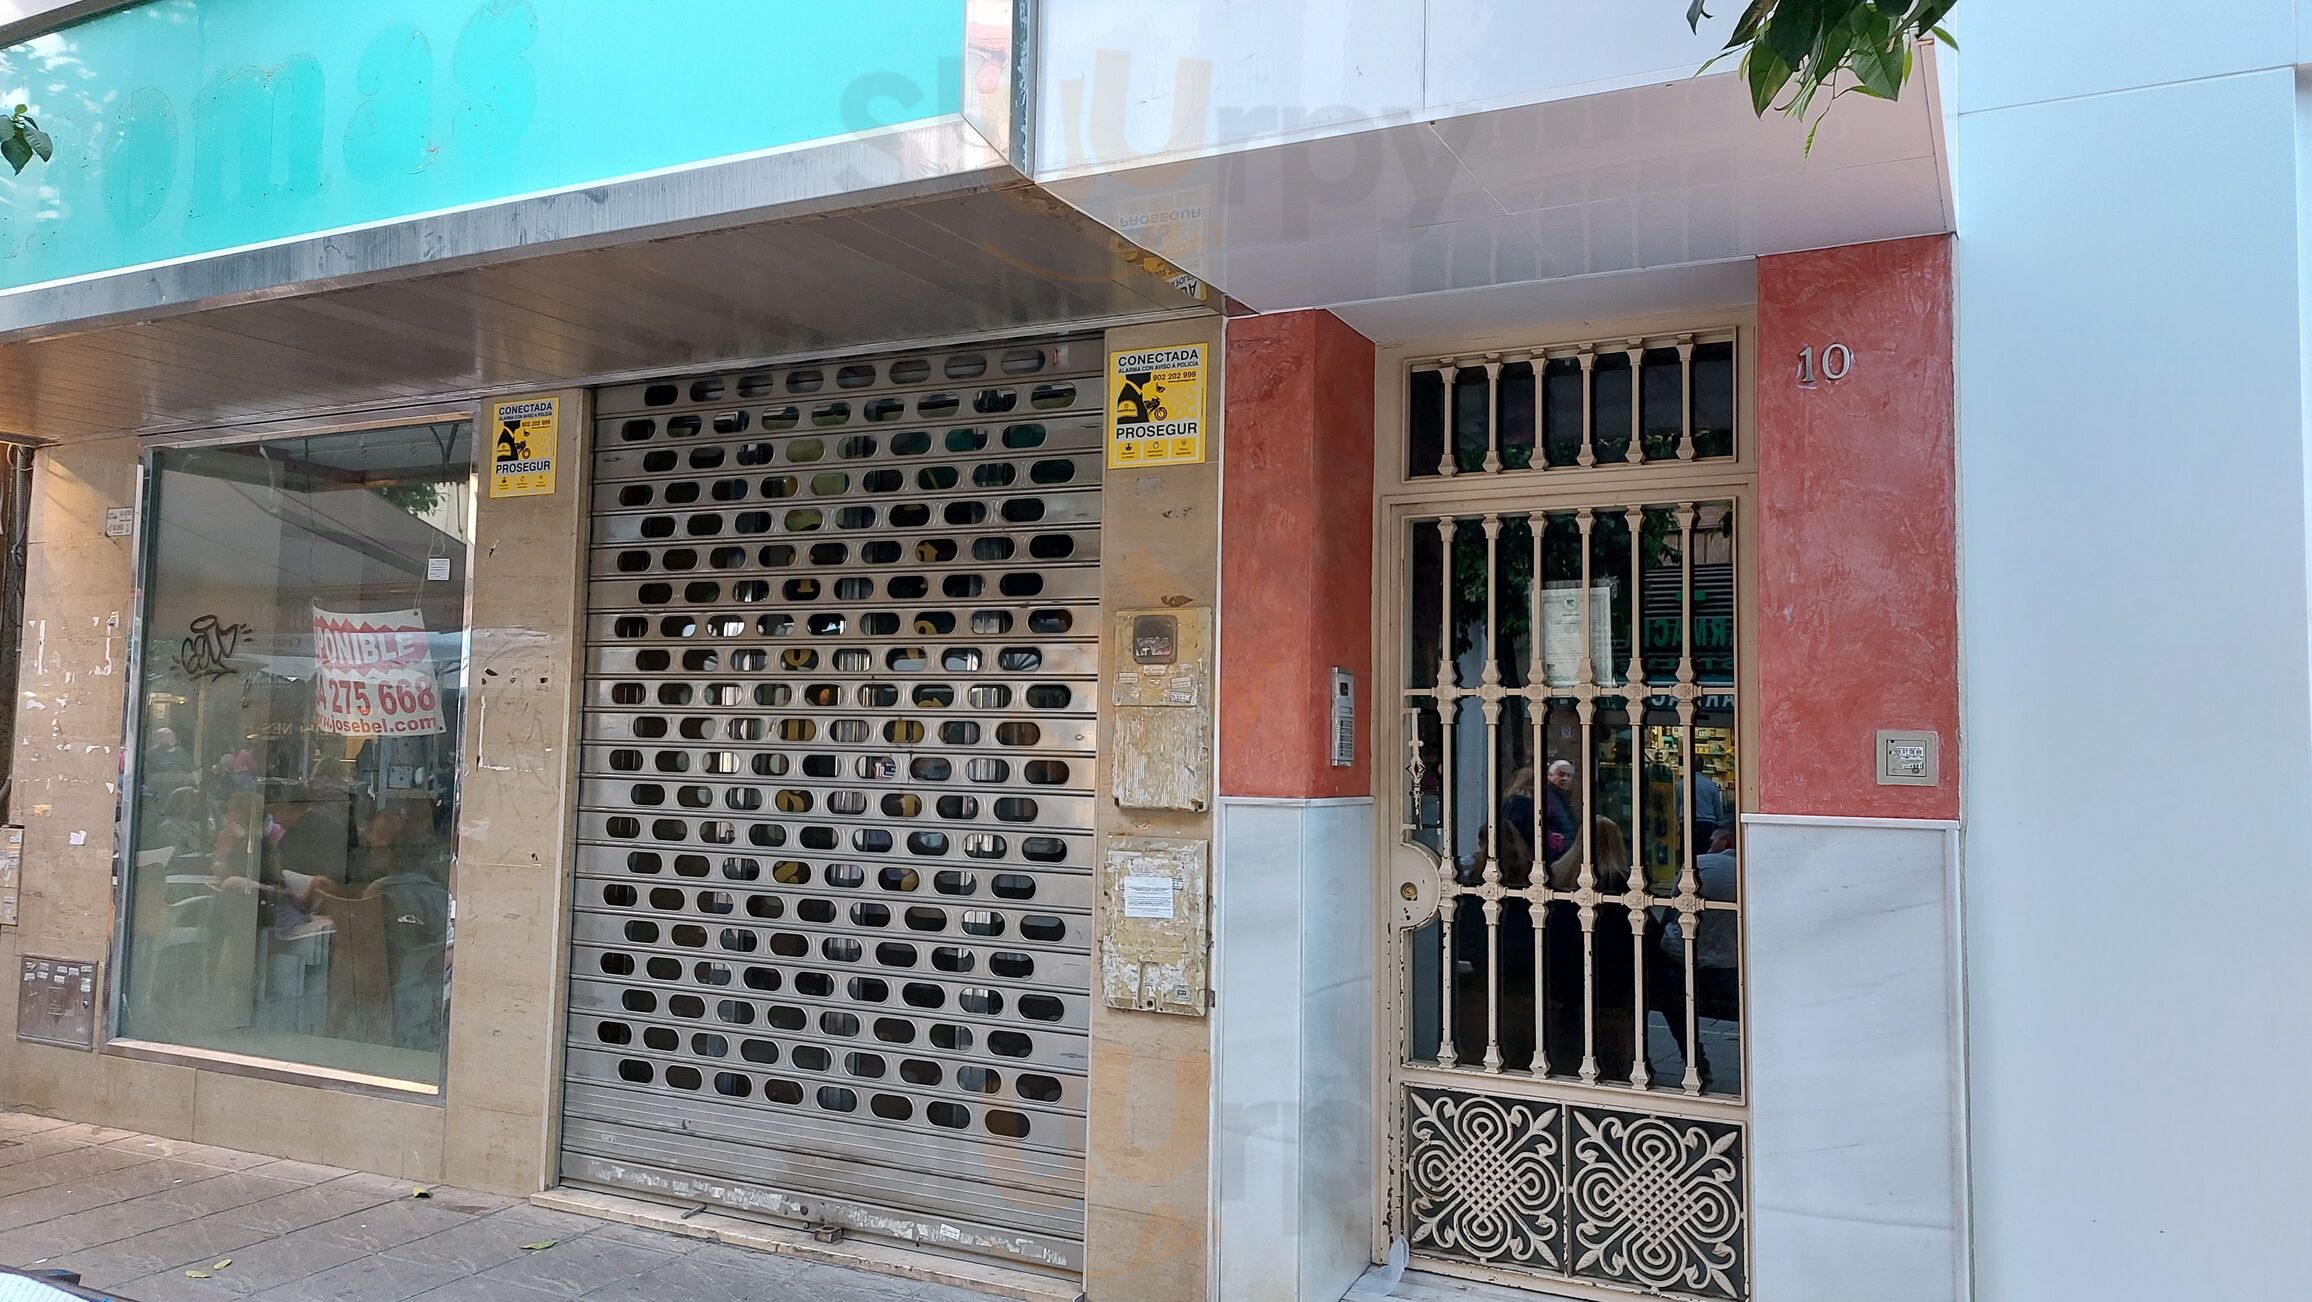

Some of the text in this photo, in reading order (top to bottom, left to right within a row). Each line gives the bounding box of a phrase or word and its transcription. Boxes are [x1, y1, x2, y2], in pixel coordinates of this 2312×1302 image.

[1118, 349, 1198, 367] CONECTADA
[1799, 343, 1851, 383] 10
[499, 402, 552, 416] CONECTADA
[1116, 422, 1197, 440] PROSEGUR
[496, 461, 550, 474] PROSEGUR
[316, 626, 416, 666] PONIBLE
[329, 678, 372, 716] 275
[379, 676, 436, 715] 668
